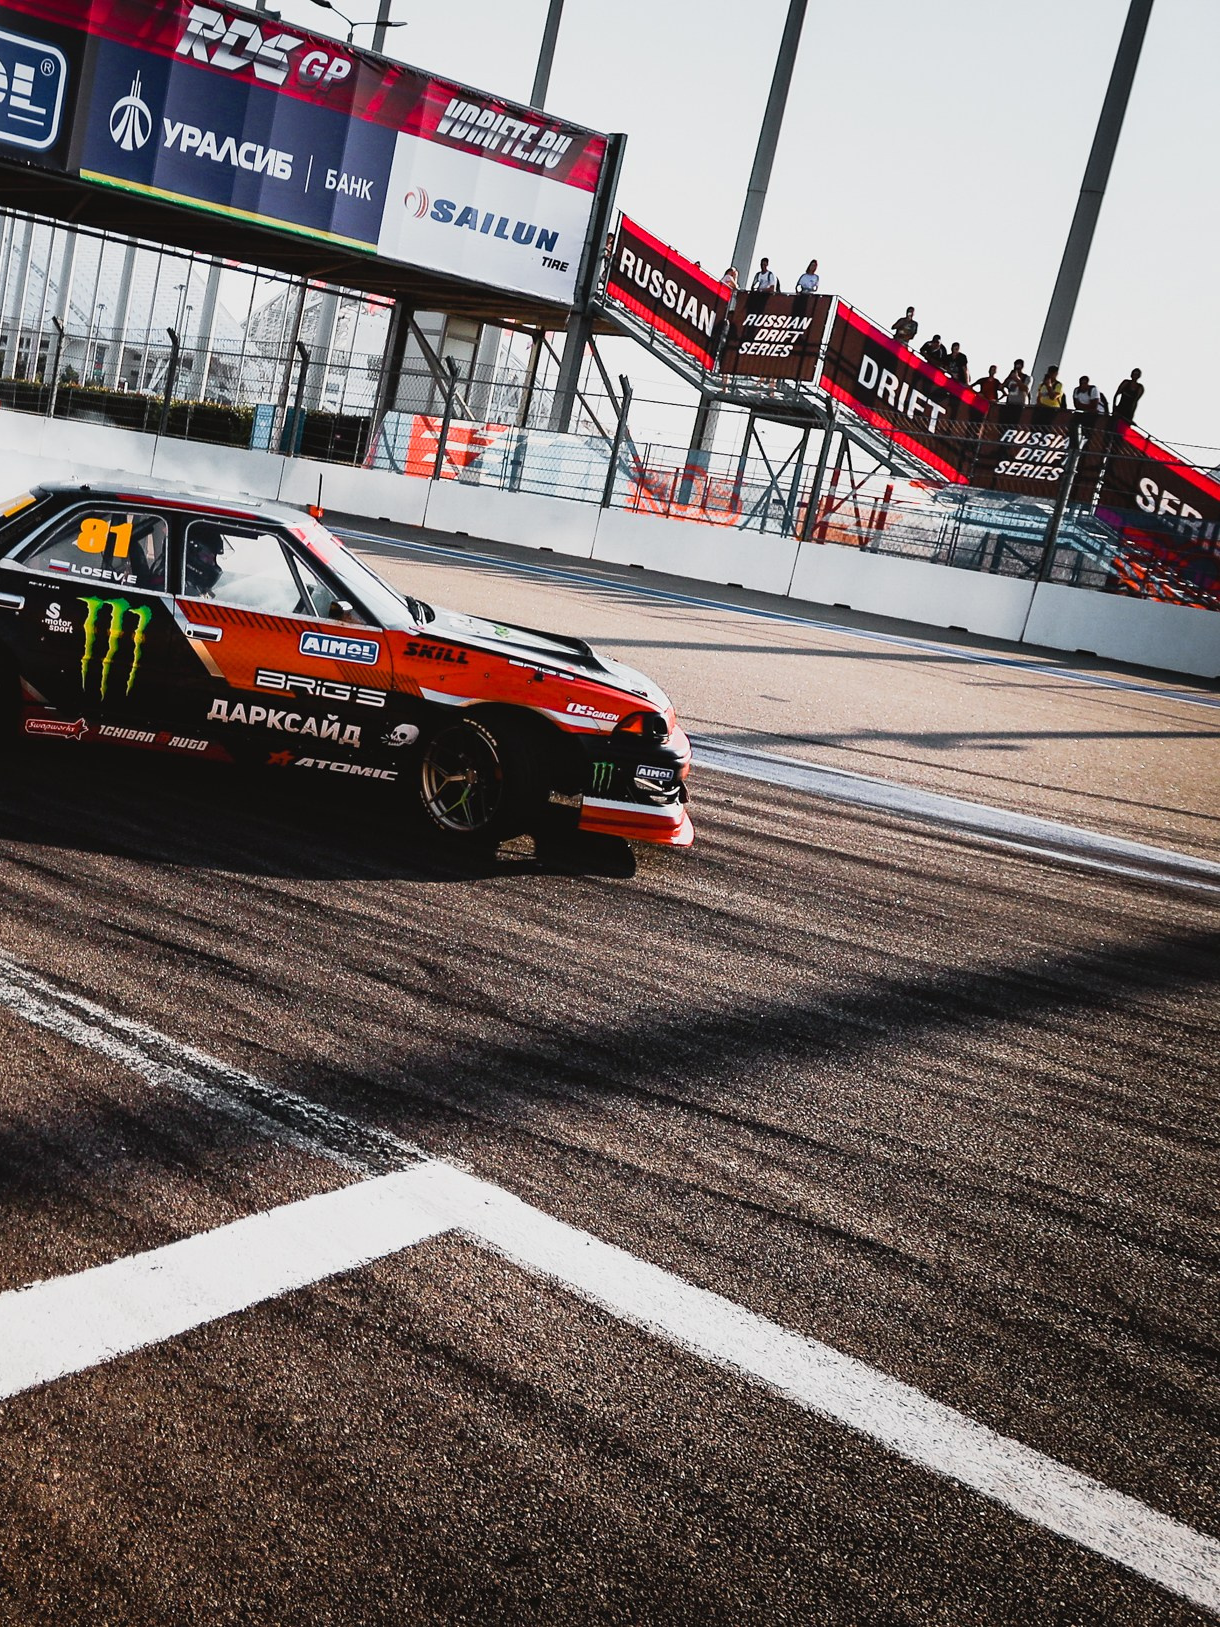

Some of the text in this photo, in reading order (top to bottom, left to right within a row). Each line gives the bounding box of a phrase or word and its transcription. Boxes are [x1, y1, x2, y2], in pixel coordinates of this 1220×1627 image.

[175, 4, 352, 90] RDS GP
[163, 117, 374, 201] УРАЛСИБ БАНК
[430, 199, 560, 253] SAILUN
[541, 256, 569, 272] TIRE
[619, 246, 717, 338] RUSSIAN
[742, 313, 812, 330] RUSSIAN
[754, 328, 805, 343] DRIFT
[738, 341, 794, 358] SERIES
[857, 354, 947, 434] DRIFT
[994, 460, 1065, 481] SERIES
[76, 517, 133, 558] 81
[44, 618, 72, 627] motor
[49, 624, 73, 634] sport
[207, 698, 362, 748] ДАРКСАЙД
[168, 735, 209, 751] AUTO
[294, 757, 399, 781] ATOMIC
[638, 767, 671, 778] AIMOL
